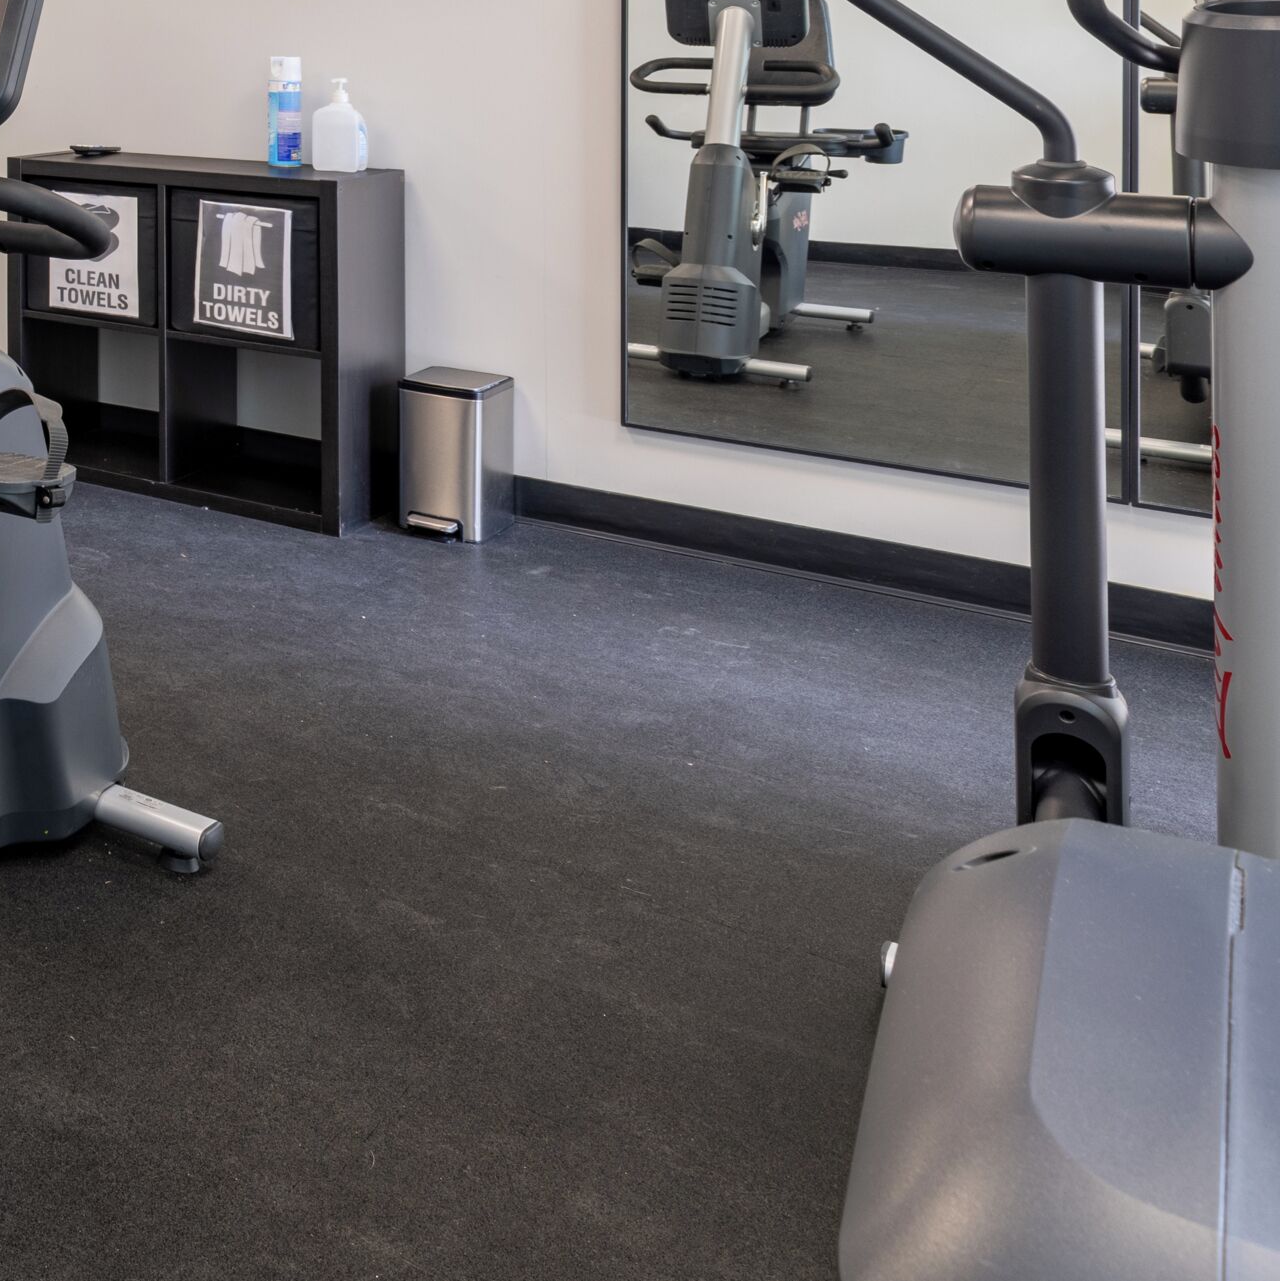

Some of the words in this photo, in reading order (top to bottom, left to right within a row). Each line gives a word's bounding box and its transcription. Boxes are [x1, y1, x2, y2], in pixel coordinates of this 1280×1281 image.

[64, 268, 120, 290] CLEAN
[57, 287, 129, 310] TOWELS
[213, 283, 271, 307] DIRTY
[203, 301, 279, 330] TOWELS
